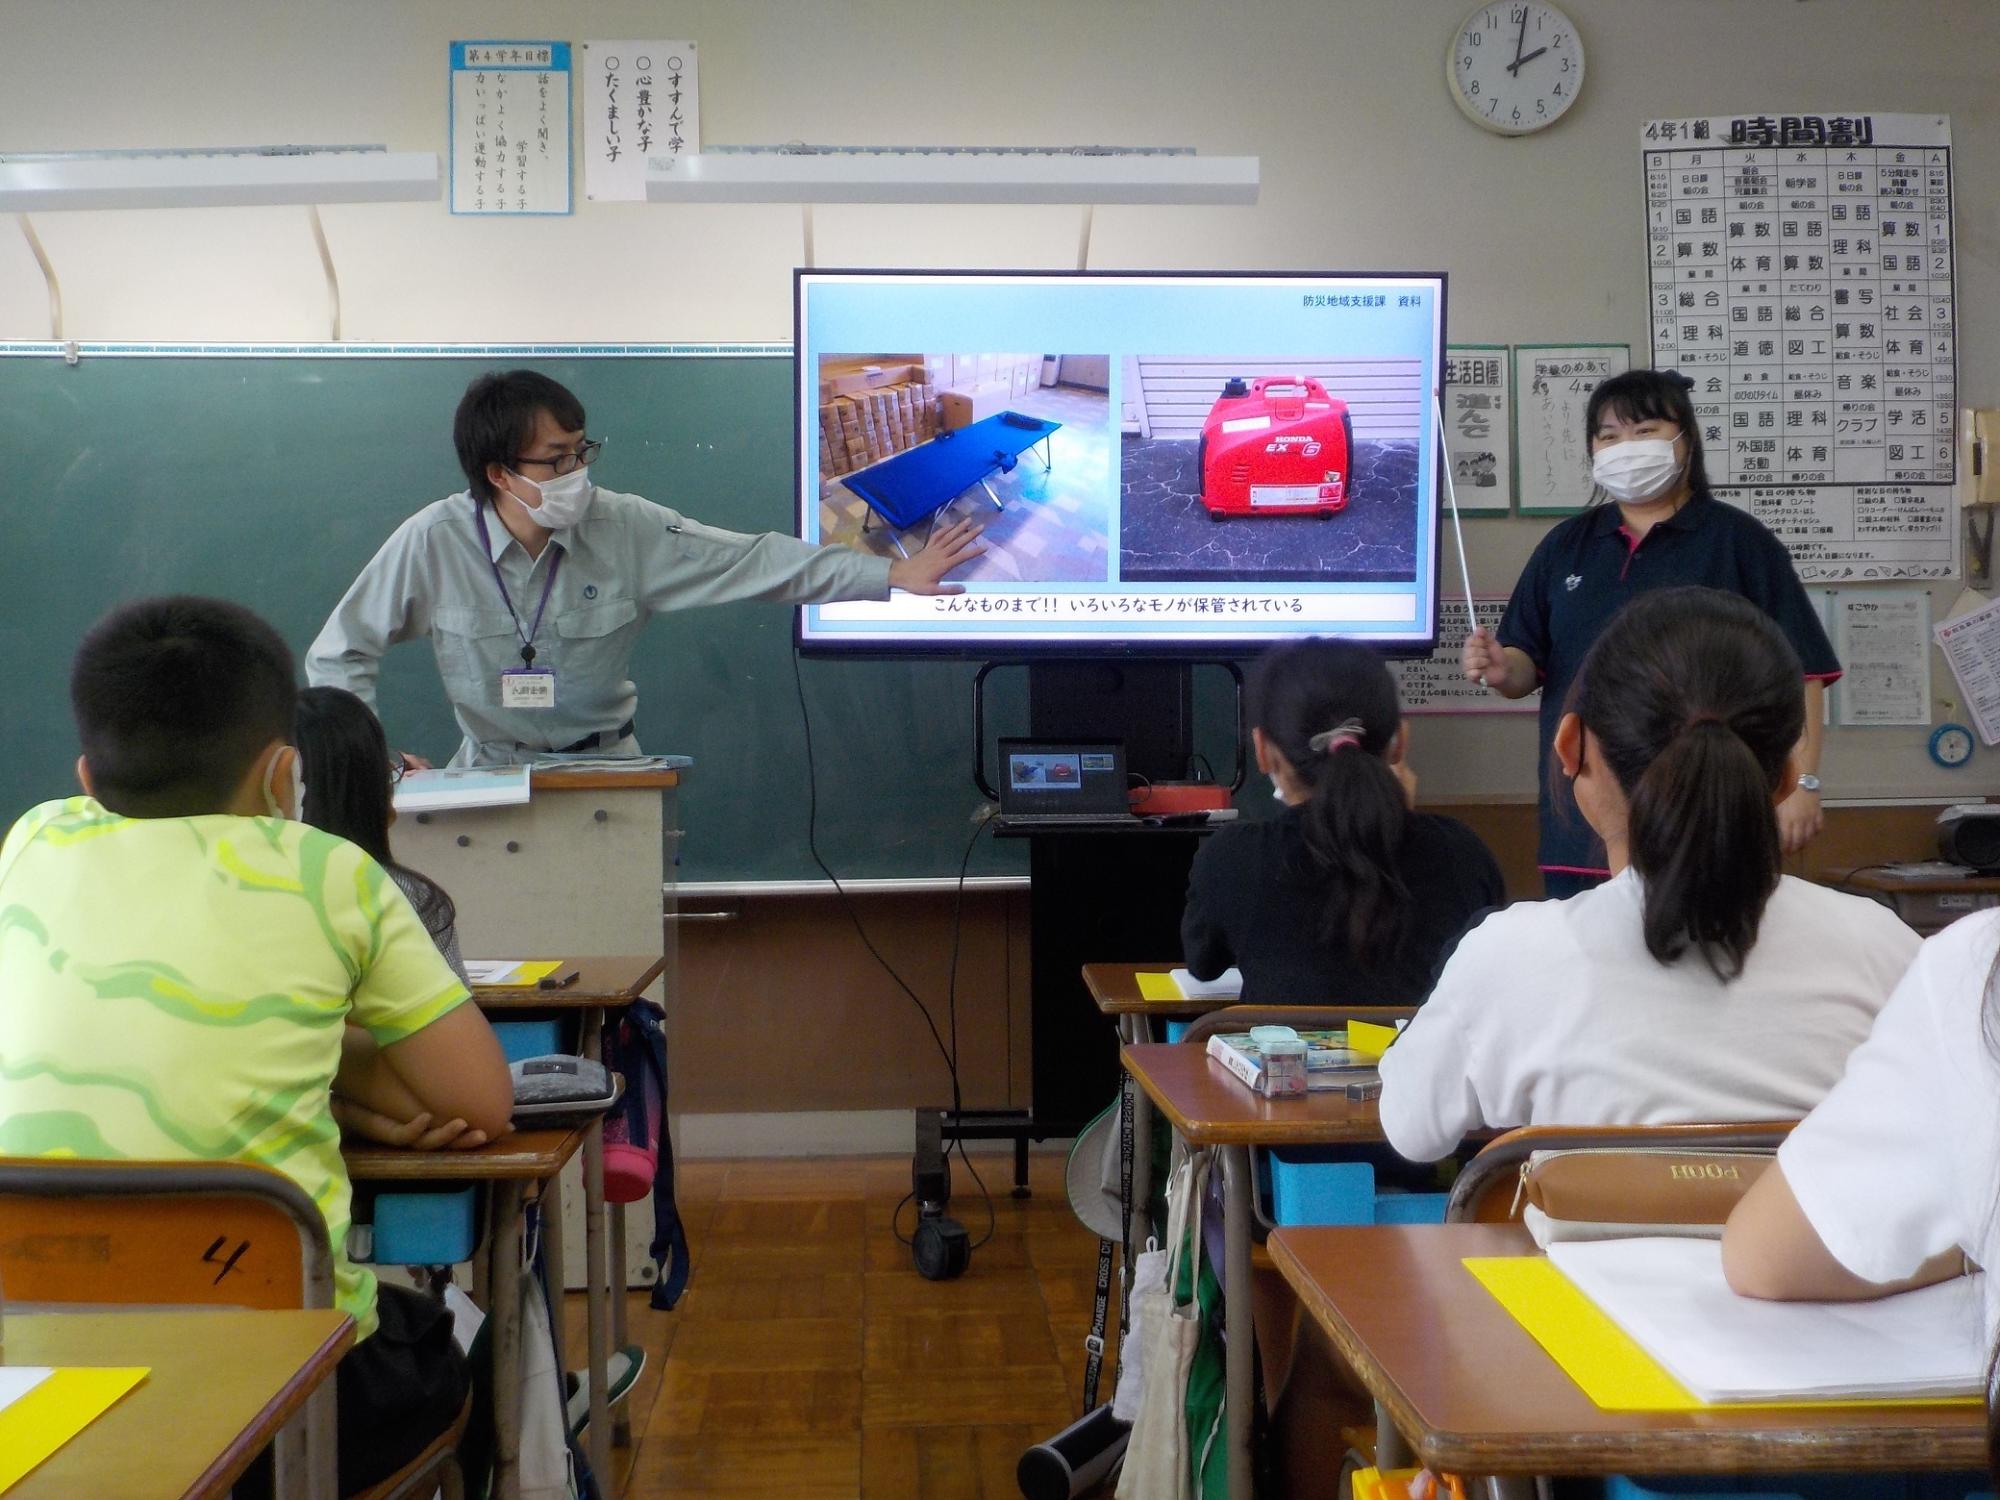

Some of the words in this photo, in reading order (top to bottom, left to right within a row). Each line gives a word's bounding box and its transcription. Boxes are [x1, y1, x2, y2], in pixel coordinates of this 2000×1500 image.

[1487, 15, 1497, 29] 11
[1511, 9, 1523, 23] 12
[1469, 32, 1481, 46] 10
[1553, 34, 1561, 48] 2
[1464, 56, 1473, 70] 9
[1561, 58, 1569, 72] 3
[1471, 80, 1480, 94] 8
[1553, 82, 1562, 96] 4
[1489, 99, 1498, 113] 7
[1512, 105, 1521, 119] 6
[1536, 99, 1545, 114] 5
[1646, 120, 1710, 141] 4年1組
[1731, 116, 1873, 145] 時間割
[1691, 154, 1702, 165] 月
[1745, 153, 1755, 163] 火
[1796, 152, 1807, 162] 水
[1846, 152, 1857, 161] 木
[1895, 153, 1905, 163] 金
[1931, 153, 1941, 162] A
[516, 140, 528, 209] 学習する子
[1676, 208, 1717, 224] 国語
[1832, 204, 1871, 220] 国語
[1783, 221, 1822, 237] 国語
[1656, 245, 1666, 256] 2
[1833, 239, 1872, 255] 理科
[1731, 256, 1772, 272] 体育
[1883, 255, 1920, 271] 国語
[1935, 257, 1945, 269] 2
[1303, 295, 1386, 307] 防災地域支援課
[1398, 295, 1421, 307] 資料
[1658, 294, 1668, 306] 3
[1679, 290, 1720, 307] 総合
[1732, 305, 1773, 322] 国語
[1885, 305, 1923, 321] 社会
[1936, 307, 1946, 319] 3
[1660, 328, 1670, 339] 4
[1682, 325, 1723, 341] 理科
[1733, 340, 1774, 356] 道徳
[1788, 340, 1827, 355] 図工
[1886, 339, 1924, 355] 体育
[1937, 341, 1947, 352] 4
[1837, 374, 1876, 390] 音楽
[1733, 411, 1774, 428] 国語
[1786, 410, 1827, 427] 理科
[1888, 409, 1926, 425] 学活
[1940, 412, 1949, 424] 5
[1837, 418, 1878, 432] クラブ
[1265, 444, 1288, 453] EX
[1736, 440, 1776, 453] 外国語
[1787, 446, 1828, 461] 体育
[1889, 444, 1926, 460] 図工
[1939, 447, 1948, 459] 6
[1744, 456, 1770, 470] 活動
[1070, 597, 1303, 613] いろいろなモノが保管されている
[1670, 1163, 1739, 1181] POOH
[202, 1236, 250, 1285] 4
[1099, 1257, 1110, 1289] CROSS
